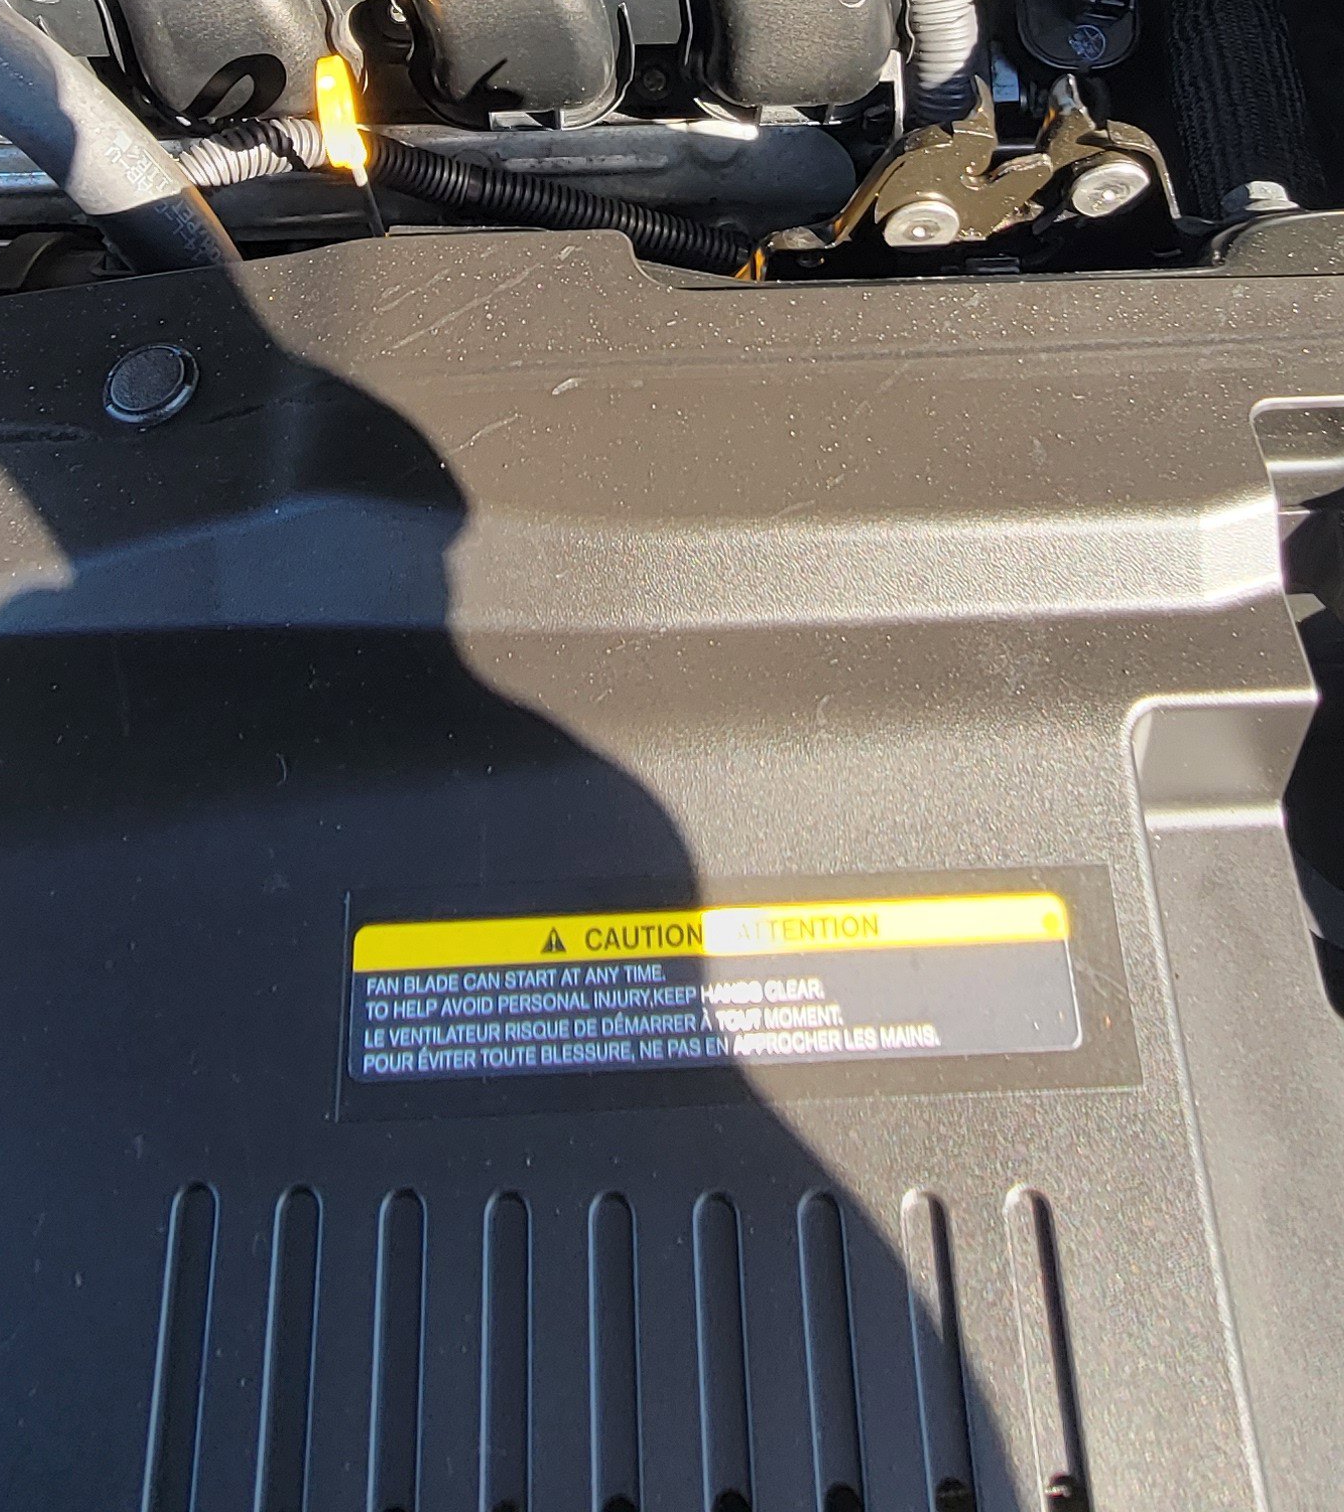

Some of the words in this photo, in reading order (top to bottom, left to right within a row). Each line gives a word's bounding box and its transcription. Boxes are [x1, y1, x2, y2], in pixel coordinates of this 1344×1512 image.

[585, 924, 703, 951] CAUTION
[738, 914, 879, 942] ATTENTION
[365, 1000, 389, 1021] TO
[393, 998, 438, 1019] HELP
[441, 995, 493, 1017] AVOID
[498, 991, 591, 1014] PERSONAL
[701, 981, 763, 1004] HAN
[764, 977, 825, 1003] CLEAR.
[367, 976, 399, 996] FAN
[404, 973, 459, 995] BLADE
[463, 971, 500, 991] CAN
[505, 968, 557, 989] START
[560, 968, 582, 986] AT
[584, 966, 619, 985] ANY
[624, 964, 666, 984] TIME.
[363, 1052, 413, 1075] POUR
[418, 1045, 476, 1071] ÉVITER
[480, 1045, 536, 1068] TOUTE
[541, 1041, 636, 1066] BLESSURE,
[639, 1039, 664, 1060] NE
[668, 1038, 701, 1058] PAS
[705, 1036, 728, 1057] EN
[843, 1027, 878, 1051] LES
[880, 1022, 941, 1049] MAINS.
[364, 1029, 385, 1049] LE
[389, 1022, 500, 1047] VENTILATEUR
[505, 1019, 570, 1041] RISQUE
[574, 1018, 598, 1037] DE
[602, 1011, 696, 1036] DÉMARRER
[763, 1004, 844, 1030] MOMENT.
